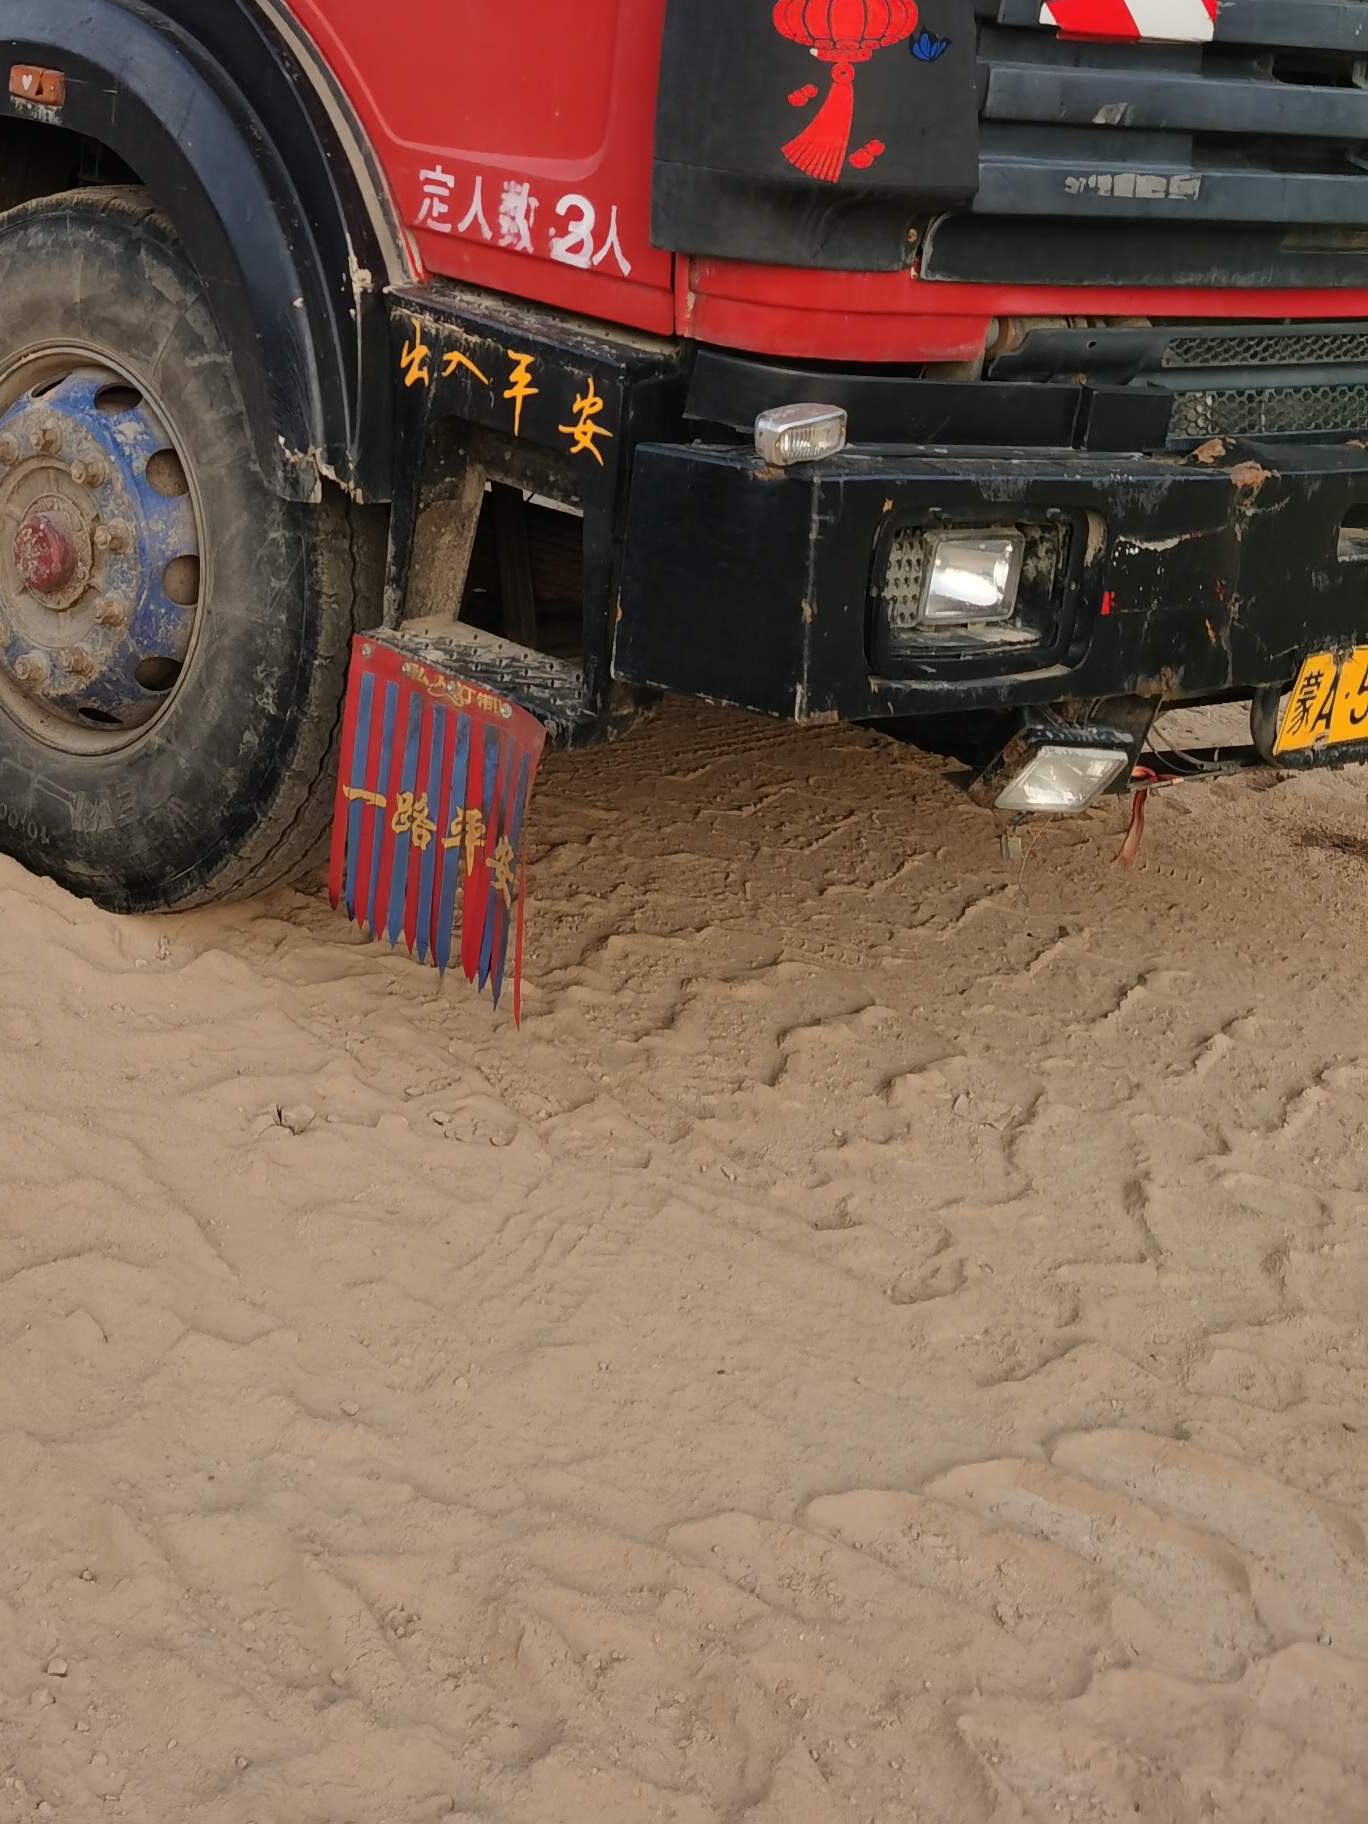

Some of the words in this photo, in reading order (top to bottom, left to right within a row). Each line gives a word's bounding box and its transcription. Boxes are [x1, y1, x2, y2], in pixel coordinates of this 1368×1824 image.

[400, 317, 614, 468] 出入平安
[342, 783, 516, 910] 一路平安
